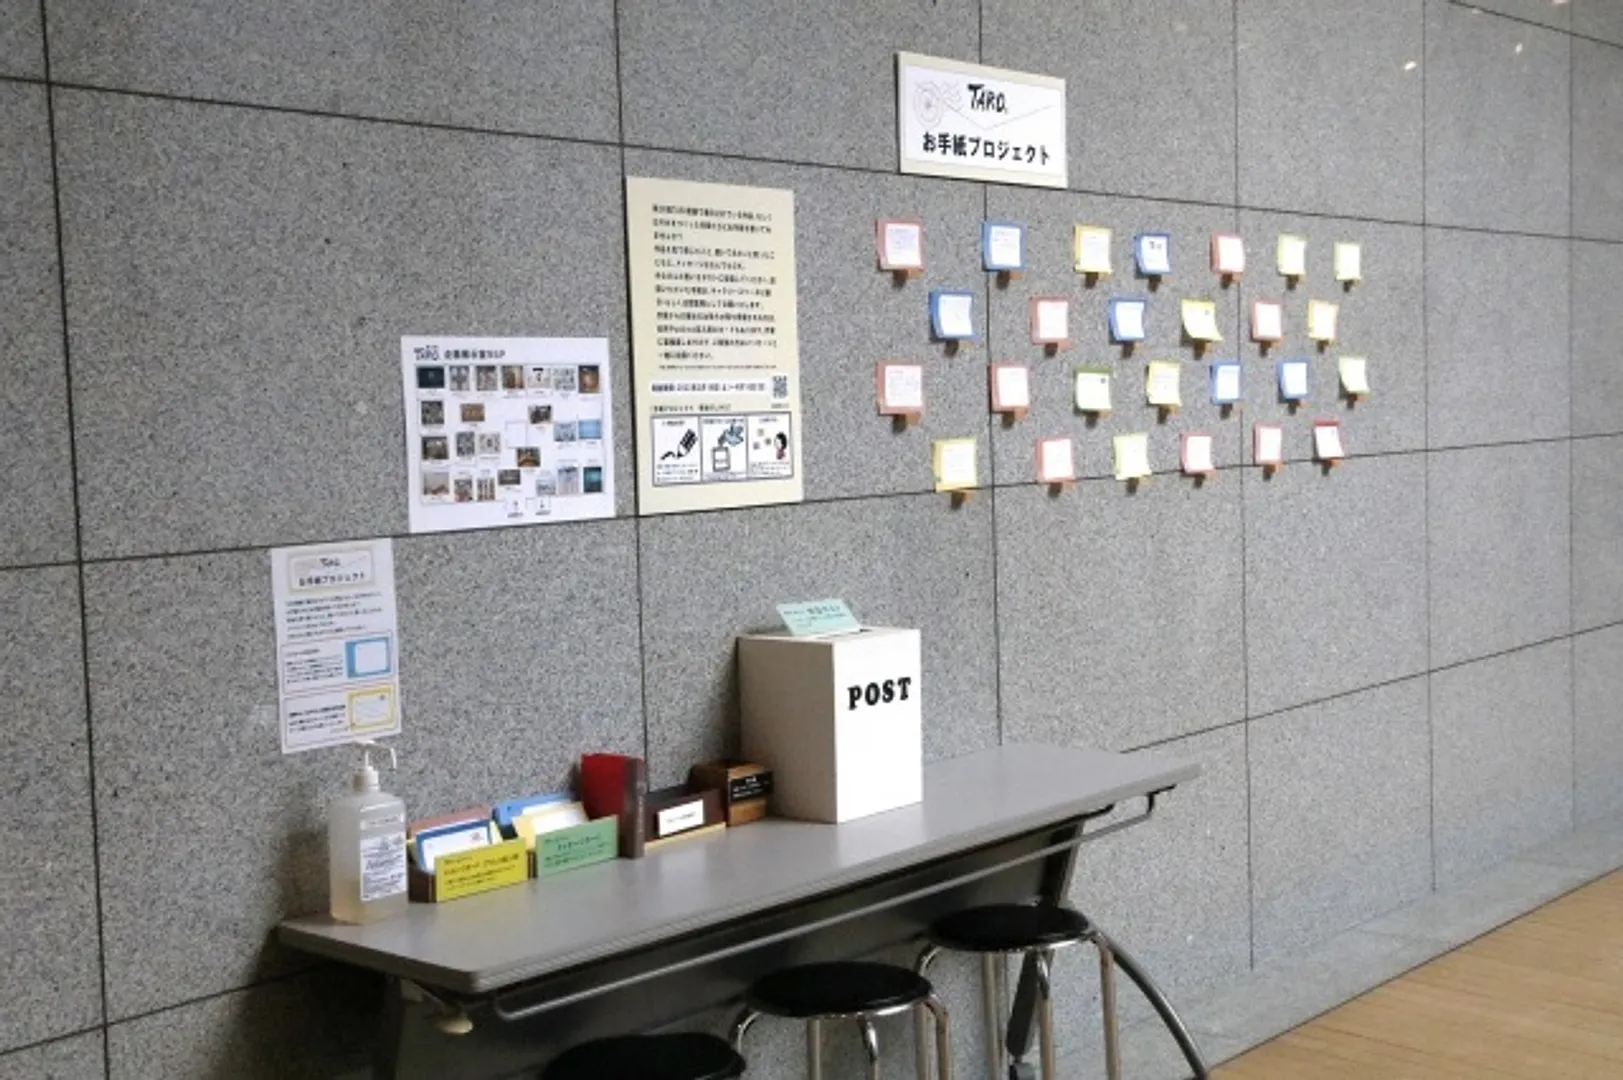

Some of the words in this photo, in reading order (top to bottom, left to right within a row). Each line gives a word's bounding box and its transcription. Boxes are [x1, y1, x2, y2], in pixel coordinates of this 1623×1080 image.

[922, 131, 1050, 166] お手紙プロジェクト
[847, 676, 911, 711] POST
